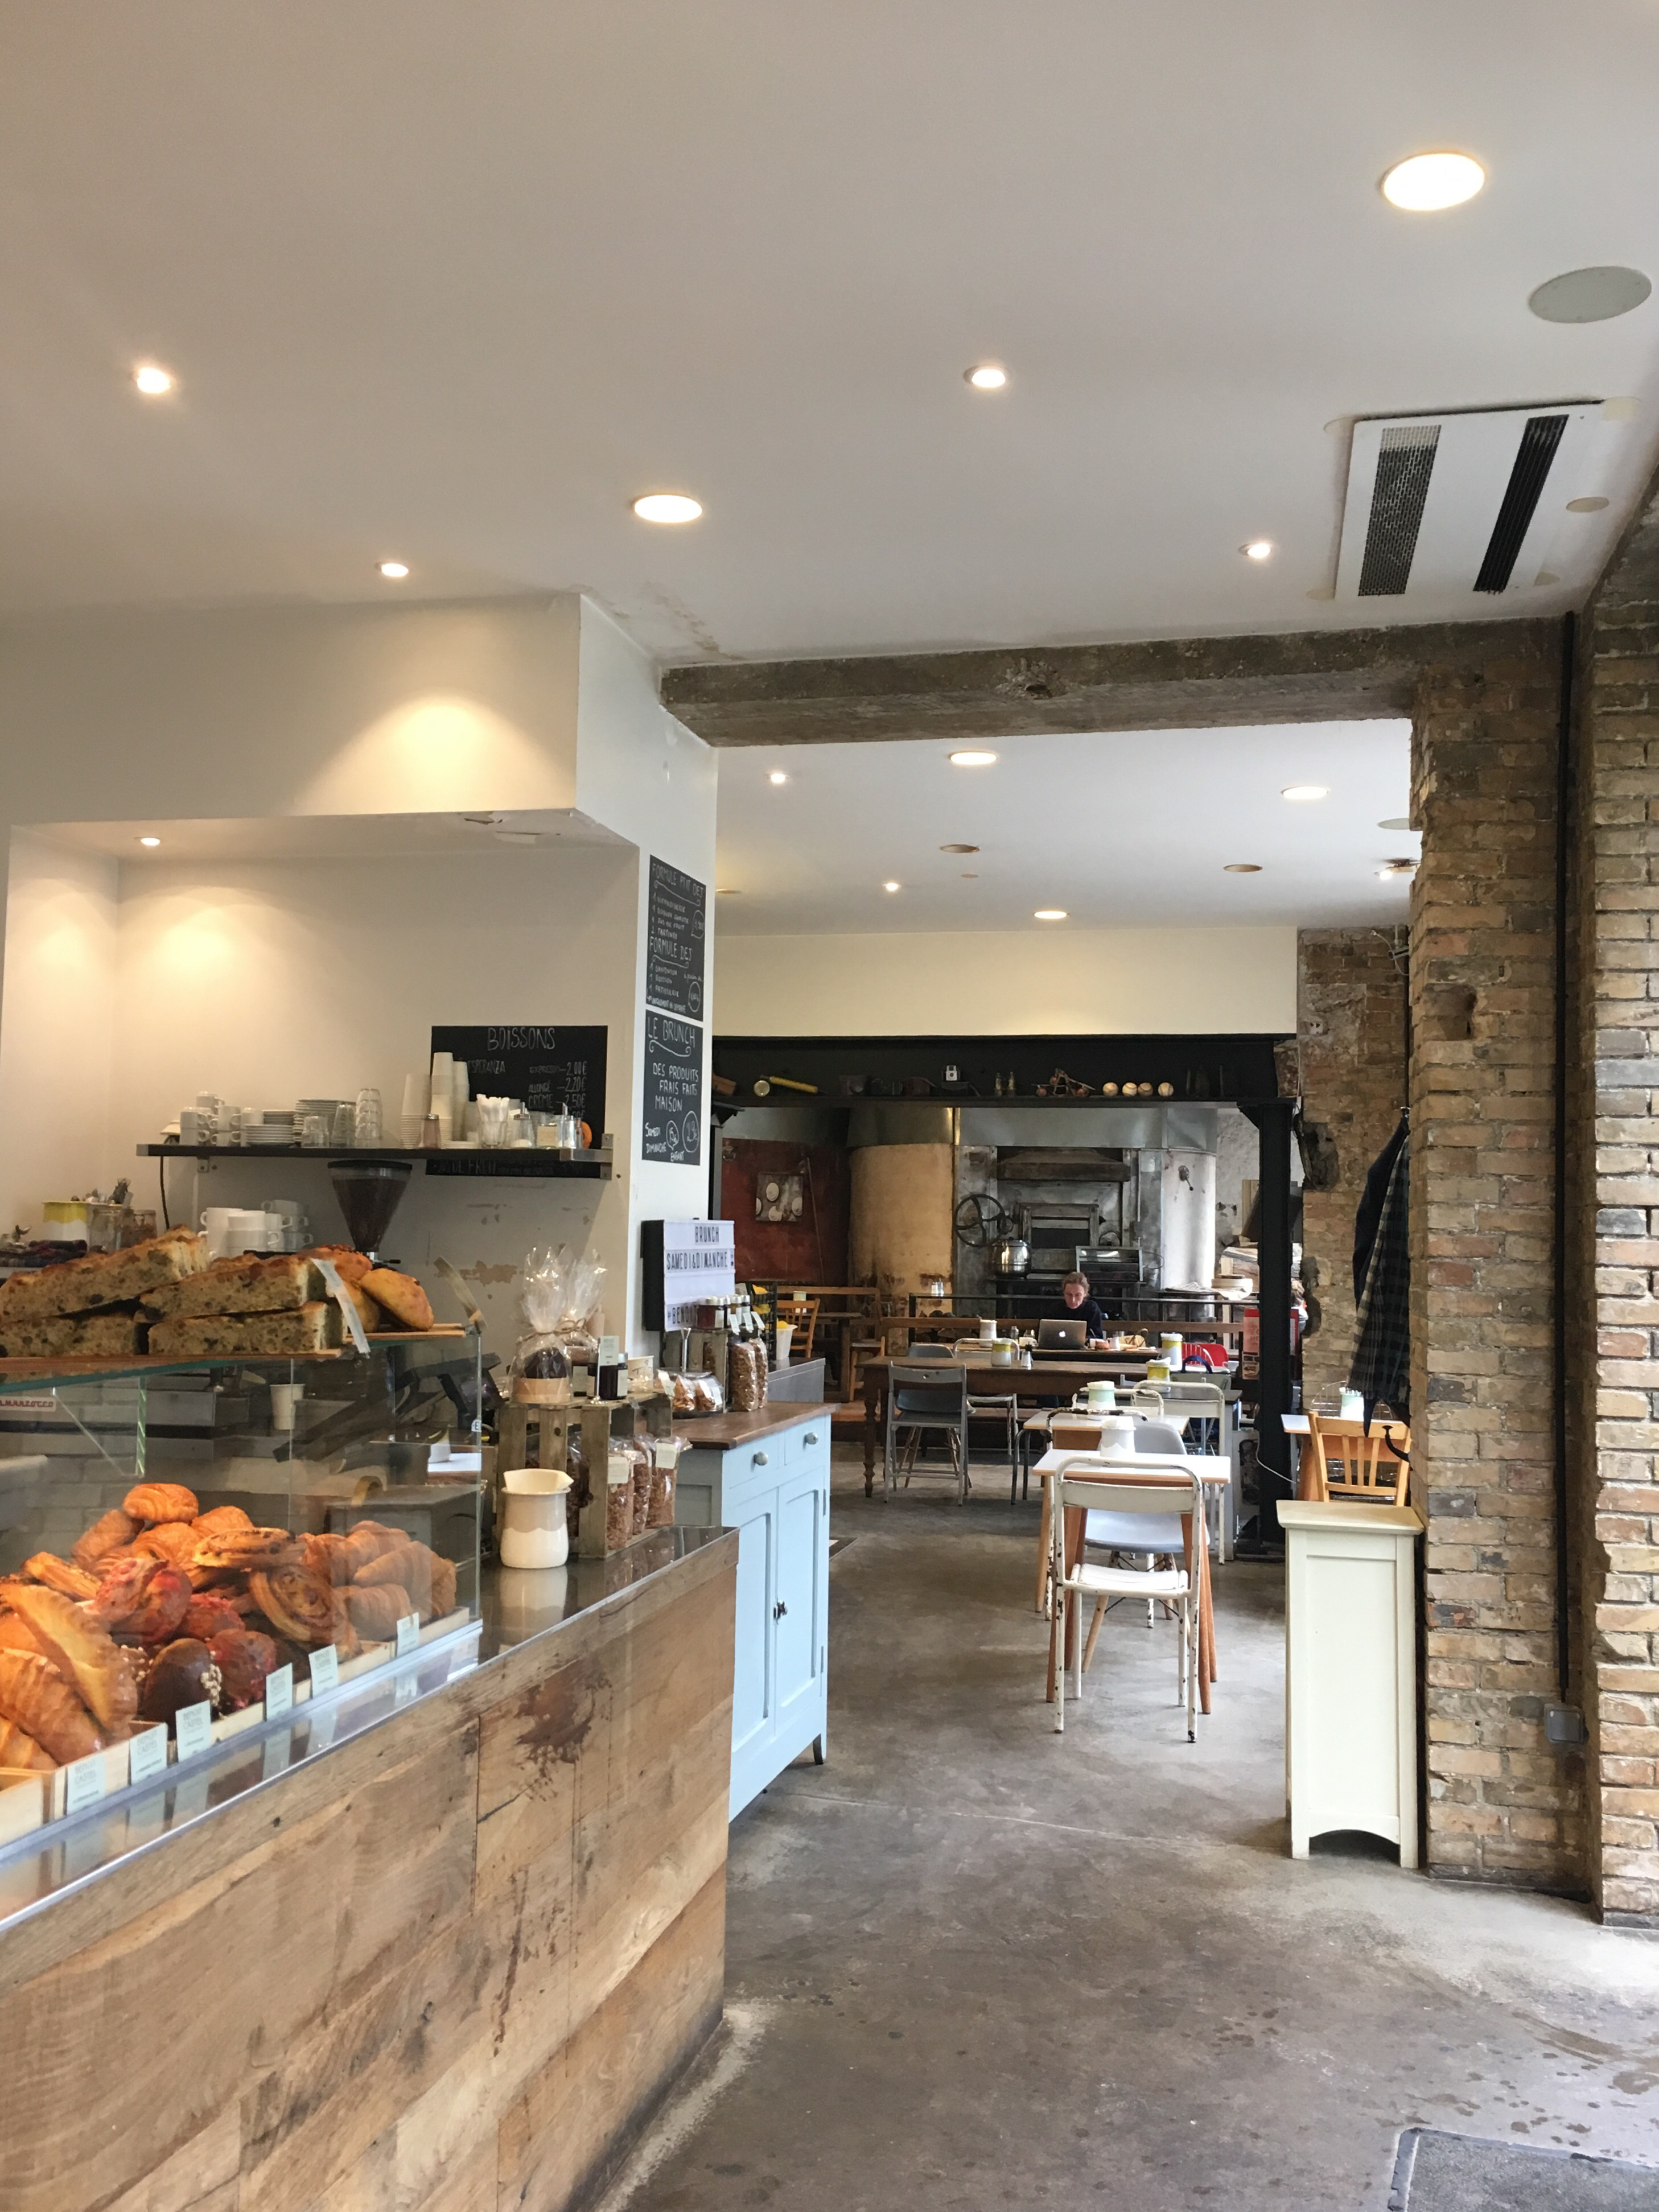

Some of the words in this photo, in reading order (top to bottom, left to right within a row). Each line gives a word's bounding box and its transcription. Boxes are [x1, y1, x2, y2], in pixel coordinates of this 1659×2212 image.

[652, 863, 677, 885] FORMULE
[649, 936, 677, 958] FORMULE
[487, 1027, 555, 1051] BOISSONS
[648, 1016, 658, 1040] LE
[662, 1019, 695, 1049] BRUNCH
[653, 1062, 665, 1077] DES
[669, 1065, 699, 1082] PRODUITS
[659, 1079, 679, 1095] FRAIS
[682, 1082, 698, 1096] FAITS
[654, 1094, 683, 1113] MAISON
[694, 1226, 719, 1243] BRUNCH
